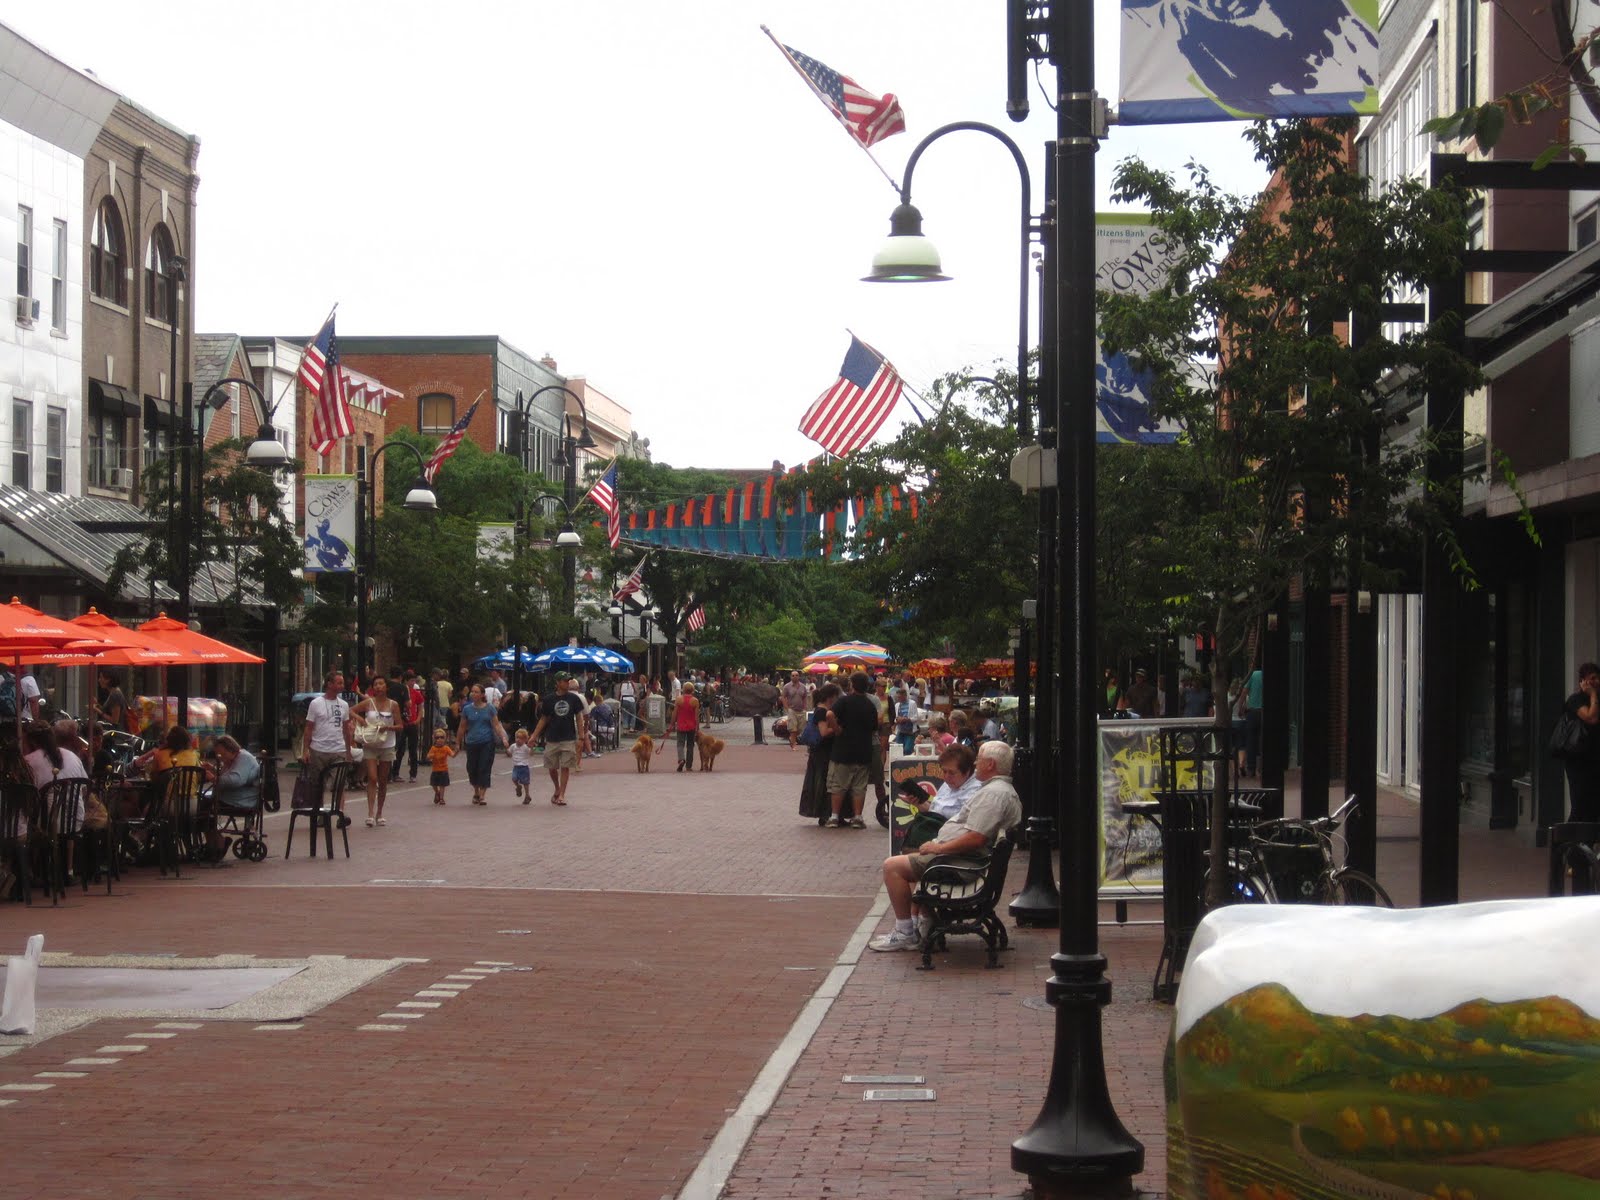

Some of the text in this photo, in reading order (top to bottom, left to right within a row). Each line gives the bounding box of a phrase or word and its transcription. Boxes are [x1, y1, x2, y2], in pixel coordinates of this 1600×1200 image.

[1096, 229, 1146, 238] itizens Bank
[1098, 257, 1121, 276] The
[892, 762, 923, 783] Good
